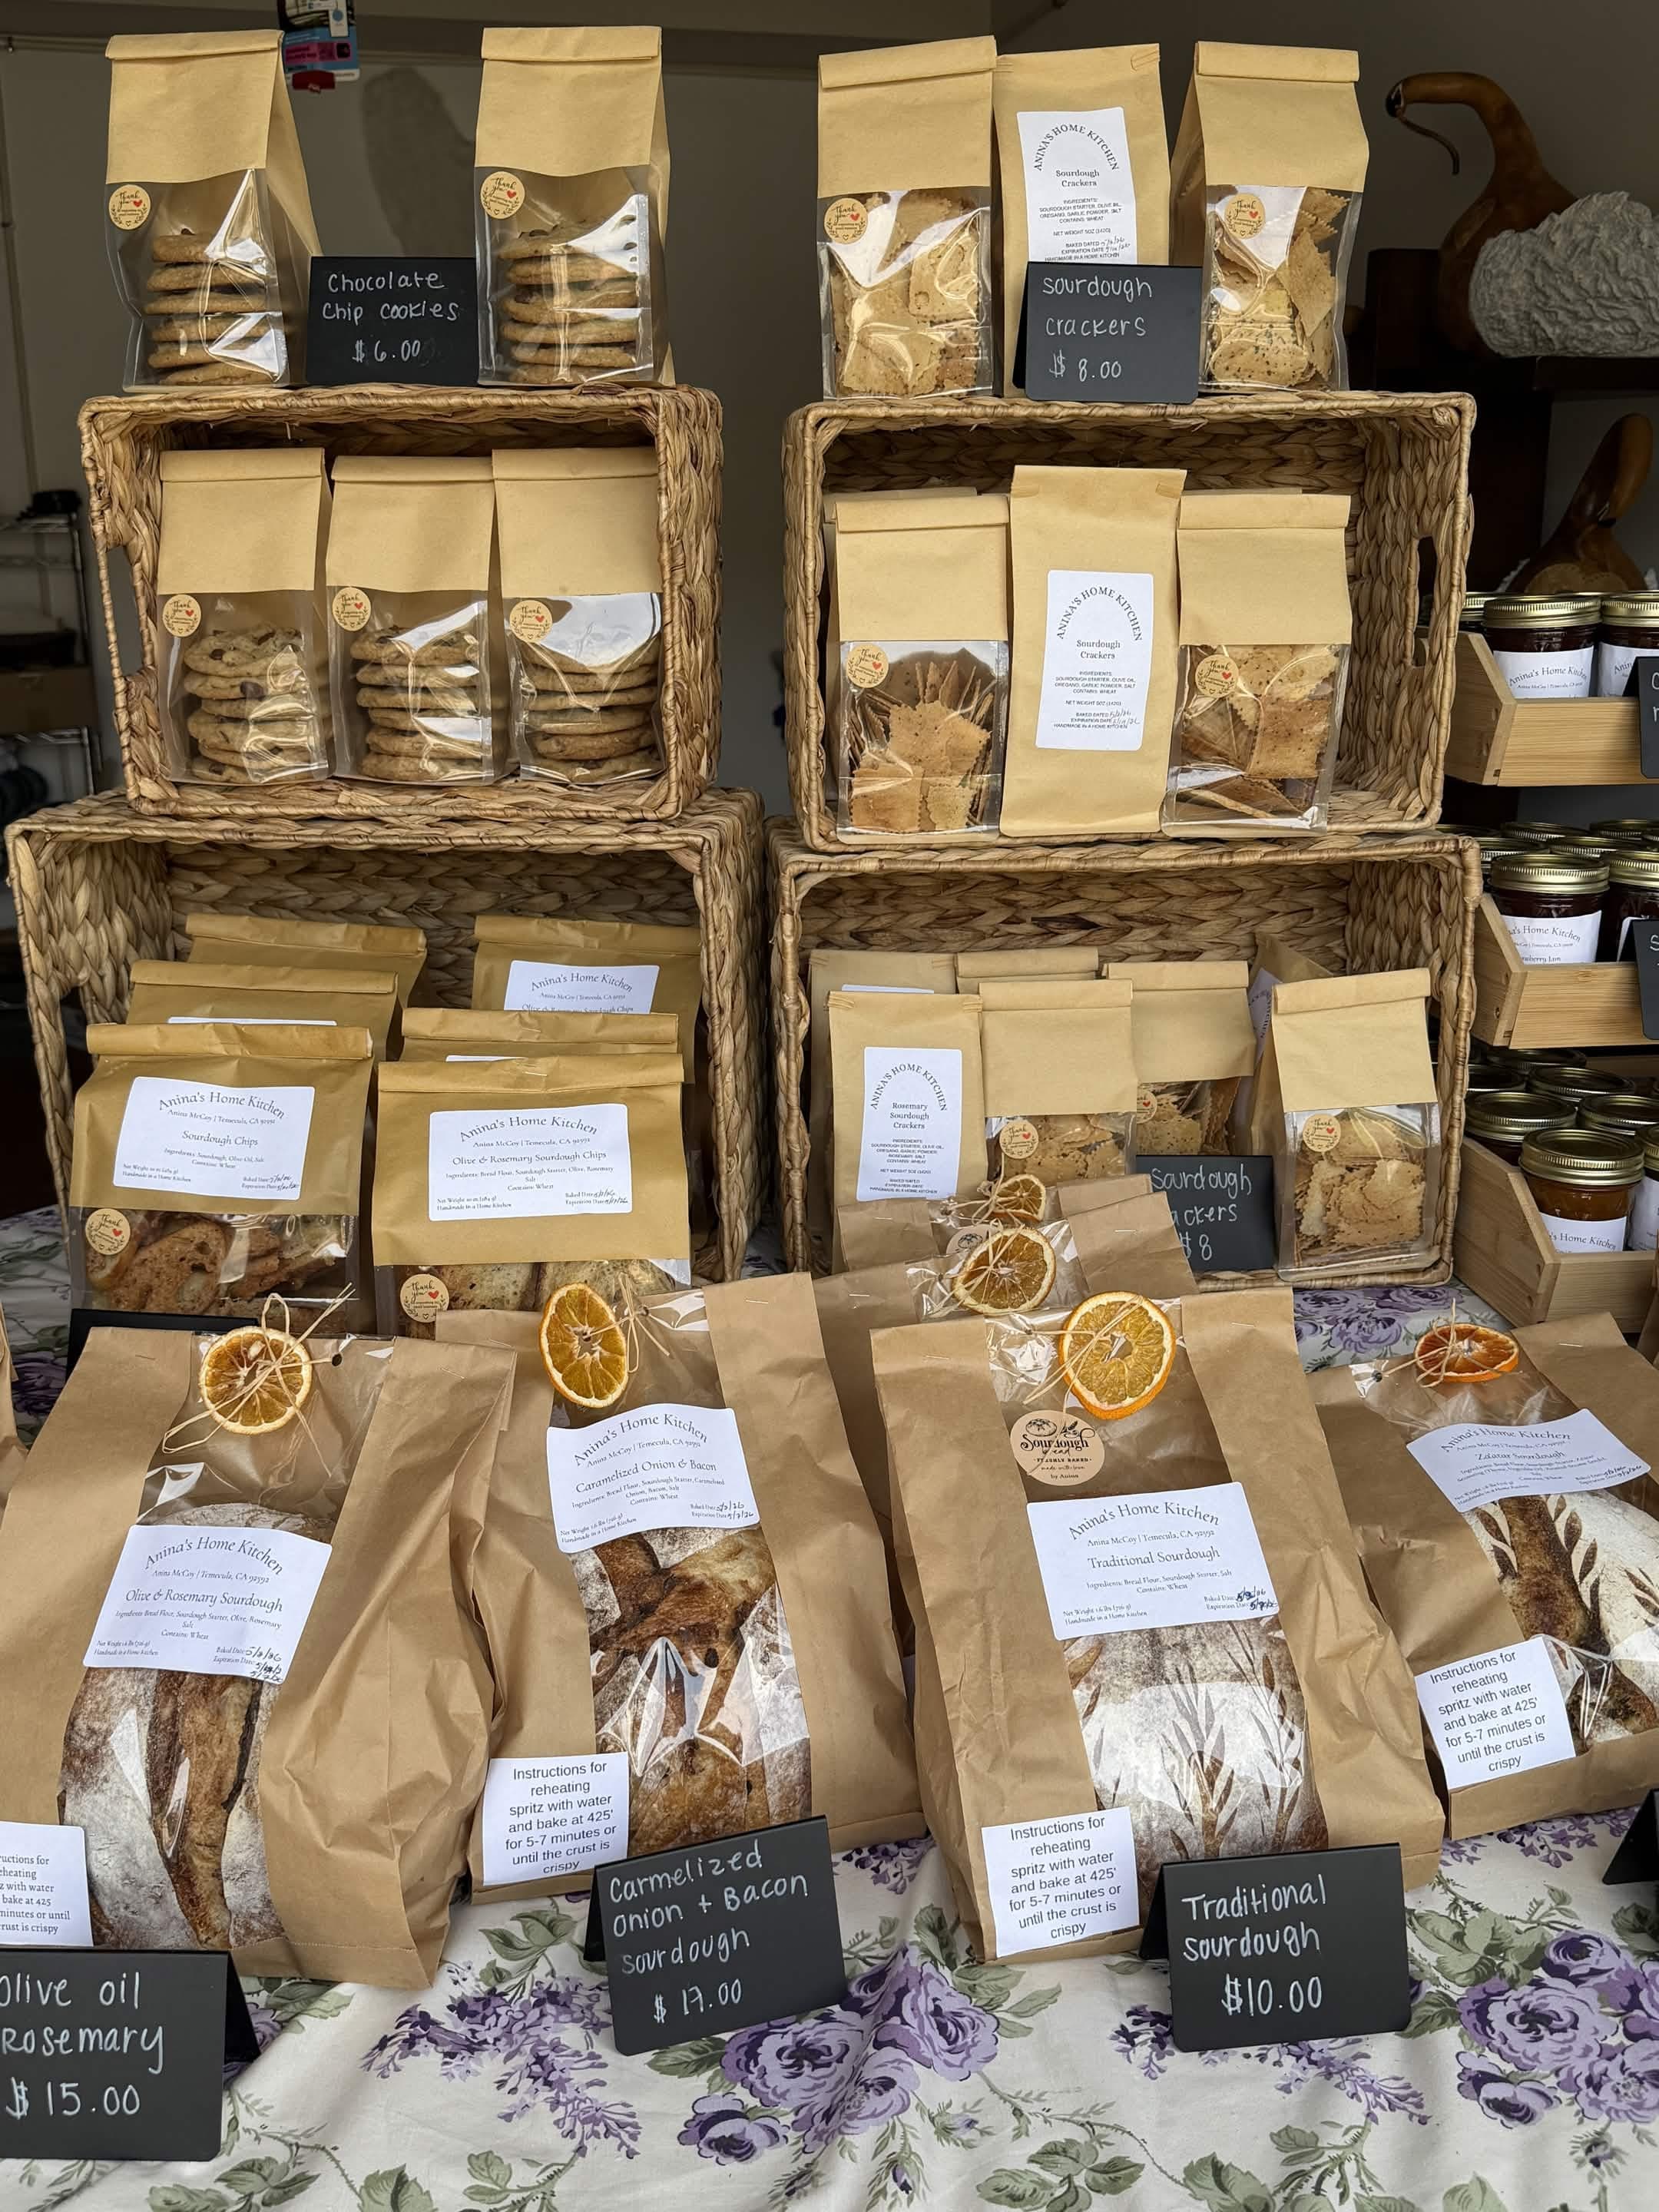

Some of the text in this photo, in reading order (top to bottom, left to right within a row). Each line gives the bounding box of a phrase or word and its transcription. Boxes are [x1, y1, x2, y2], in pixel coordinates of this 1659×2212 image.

[1034, 124, 1119, 171] ANINA'S HOME KITCHEN
[1057, 586, 1142, 641] ANINA'S HOME KITCHEN
[1076, 640, 1121, 649] Sourdough
[1080, 651, 1115, 660] Crackers
[1508, 669, 1539, 687] Anina's
[1541, 667, 1566, 675] Home
[1613, 662, 1633, 674] Anin
[1523, 926, 1549, 935] Home
[1551, 925, 1581, 942] Kitchen
[531, 972, 633, 992] Anina's Home Kitchen
[870, 1064, 947, 1111] ANINA'S HOME KITCHEN
[159, 1091, 285, 1119] Anina's Home Kitchen
[889, 1112, 929, 1121] Sourdough
[892, 1102, 928, 1111] Rosemary
[182, 1131, 258, 1147] Sourdough Chips
[459, 1116, 598, 1143] Anina's Home Kitchen
[452, 1151, 607, 1166] Olive & Rosemary Sourdough Chips
[1561, 1233, 1587, 1243] Home
[1589, 1237, 1616, 1250] Kitchen
[574, 1413, 707, 1467] Anina's Home Kitchen
[1440, 1429, 1571, 1453] Anina's Home Kitchen
[1512, 1451, 1565, 1460] Sourdough
[575, 1464, 639, 1494] Caramelized
[641, 1459, 675, 1472] Onion
[678, 1459, 687, 1468] &
[690, 1459, 717, 1472] Bacon
[1069, 1502, 1220, 1541] Anina's Home Kitchen
[1088, 1538, 1110, 1547] Anina
[1111, 1535, 1137, 1545] McCoy
[1180, 1530, 1194, 1538] CA
[145, 1536, 283, 1575] Anina's Home Kitchen
[1087, 1546, 1220, 1569] Traditional Sourdough
[153, 1569, 171, 1578] Anina
[172, 1569, 195, 1579] McCoy
[235, 1572, 248, 1581] CA
[125, 1588, 283, 1613] Olive & Rosemary Sourdough
[1430, 1651, 1516, 1684] Instructions for
[1452, 1671, 1508, 1693] reheating
[1439, 1682, 1532, 1715] spritz with water
[1444, 1716, 1466, 1731] and
[1469, 1709, 1498, 1724] bake
[1502, 1704, 1513, 1716] at
[513, 1761, 607, 1780] Instructions for
[531, 1781, 590, 1796] reheating
[510, 1796, 612, 1818] spritz with water
[508, 1821, 532, 1833] and
[537, 1817, 567, 1829] bake
[571, 1815, 583, 1825] at
[1011, 1816, 1105, 1841] Instructions for
[506, 1825, 617, 1849] for 5-7 minutes or
[1031, 1838, 1091, 1856] reheating
[512, 1840, 610, 1865] until the crust is
[543, 1860, 580, 1874] crispy
[609, 1839, 763, 1903] Carmelized
[1011, 1853, 1114, 1879] spritz with water
[724, 1874, 808, 1912] Bacon
[1012, 1881, 1035, 1893] and
[1040, 1877, 1070, 1889] bake
[1075, 1874, 1086, 1884] at
[1009, 1885, 1121, 1912] for 5-7 minutes or
[1181, 1873, 1326, 1921] Traditional
[1019, 1901, 1116, 1929] until the crust is
[1051, 1922, 1086, 1939] crispy
[99, 1972, 141, 2010] oil
[1, 2026, 164, 2075] Rosemary
